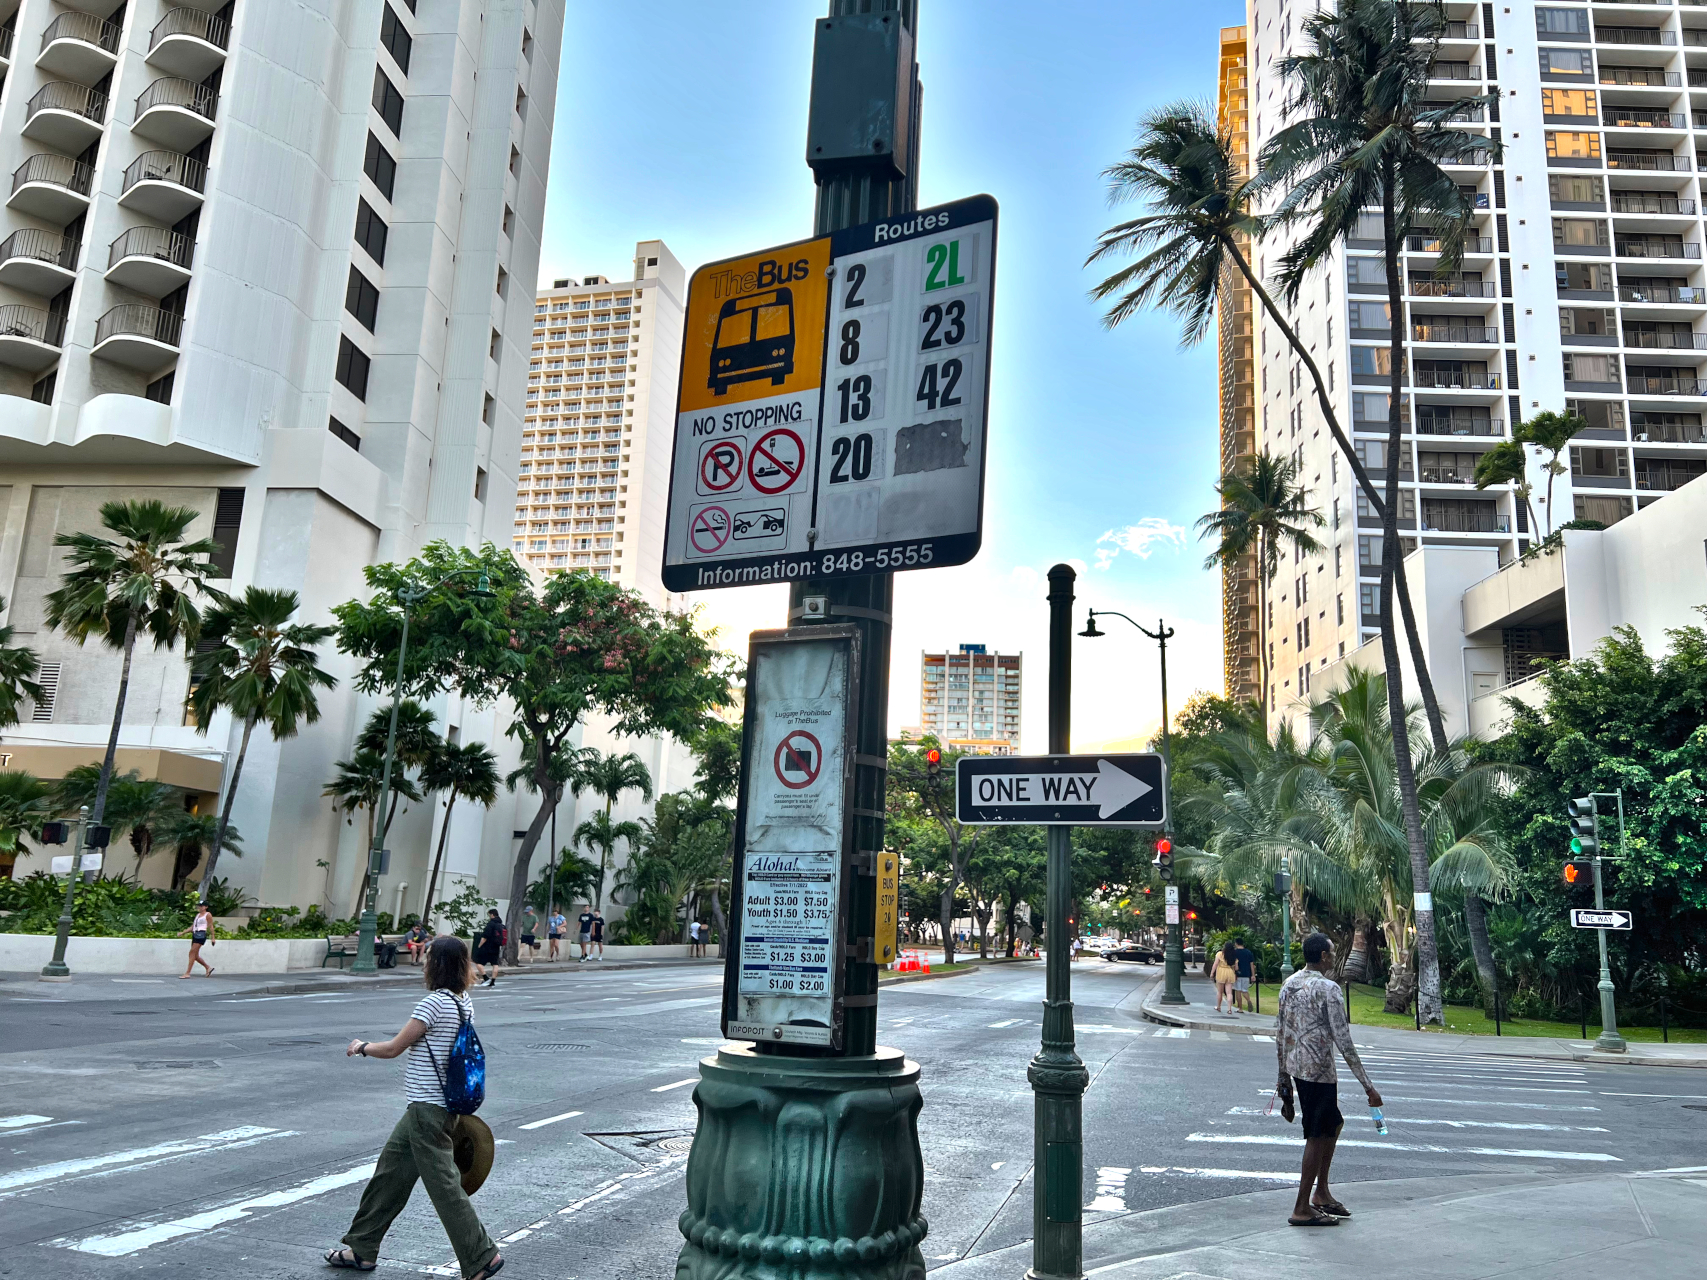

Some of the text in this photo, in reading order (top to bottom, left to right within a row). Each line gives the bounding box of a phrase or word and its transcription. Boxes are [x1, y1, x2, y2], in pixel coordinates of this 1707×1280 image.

[874, 210, 950, 243] Routes
[709, 257, 810, 299] TheBus
[845, 240, 965, 310] 2 2L
[839, 299, 966, 366] 8 23
[837, 358, 962, 424] 13 42
[692, 401, 802, 437] NO STOPPING
[829, 432, 873, 485] 20
[697, 543, 933, 586] Information: 848-5555
[978, 776, 1098, 802] ONE WAY
[748, 856, 799, 872] Aloha!
[882, 878, 894, 890] BUS
[747, 896, 828, 907] Adult $3.00 $7.50
[880, 894, 894, 906] STOP
[747, 908, 828, 919] Youth $1.50 $3.75
[1580, 915, 1595, 923] ONE
[770, 951, 794, 962] $1.25
[800, 952, 826, 963] $3.00
[769, 978, 824, 991] $1.00 $2.00
[730, 1026, 765, 1036] INFOPOST
